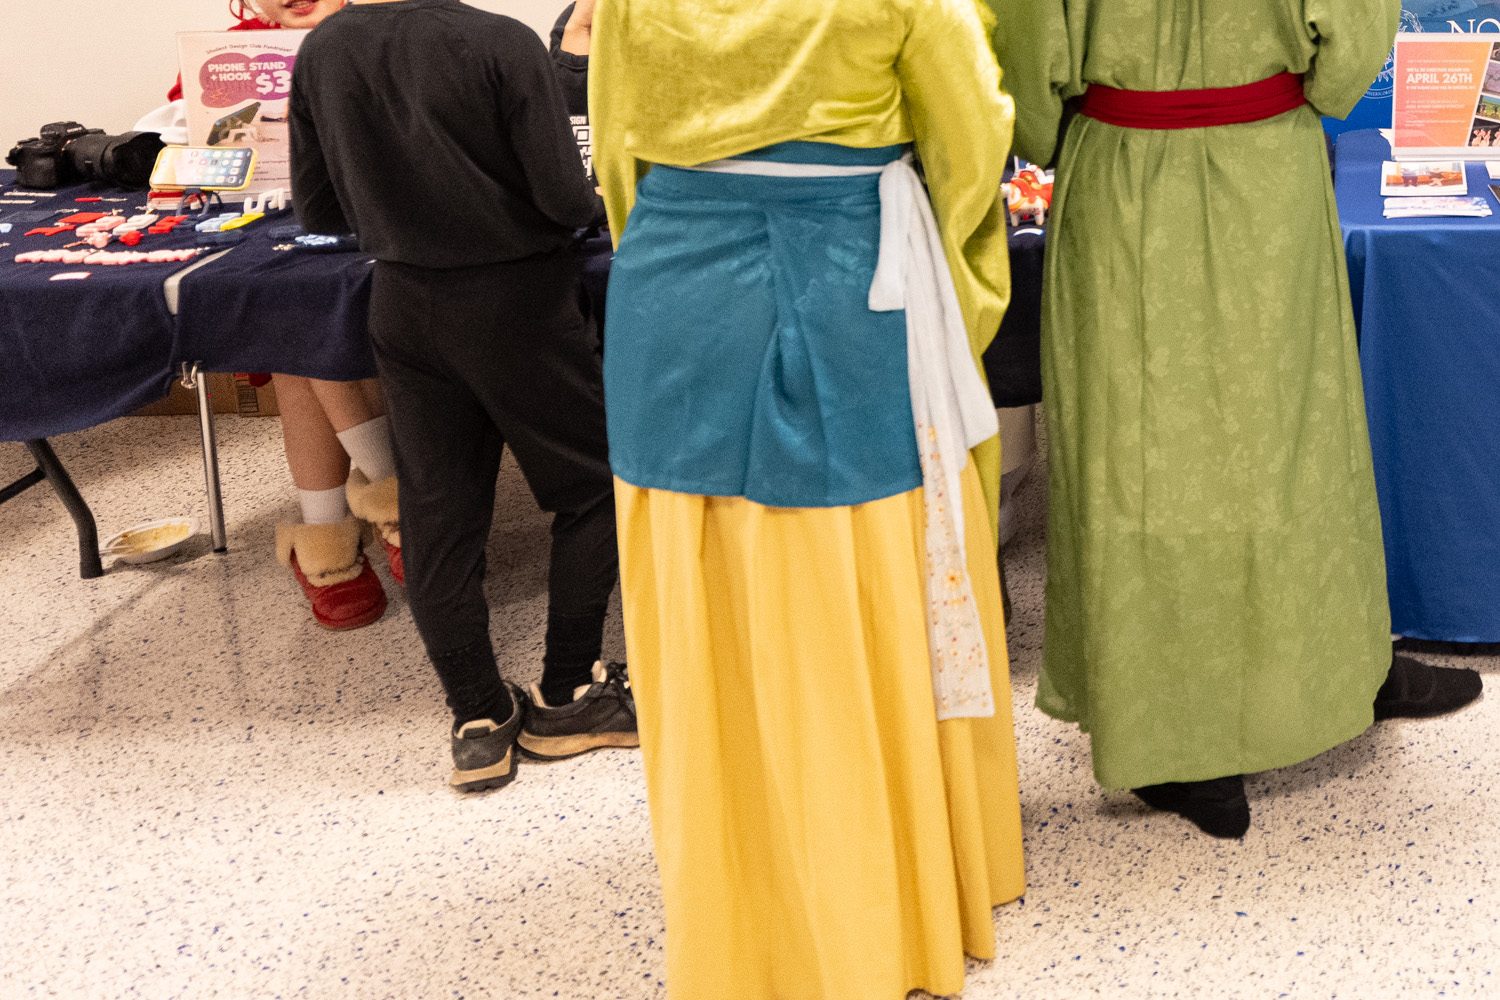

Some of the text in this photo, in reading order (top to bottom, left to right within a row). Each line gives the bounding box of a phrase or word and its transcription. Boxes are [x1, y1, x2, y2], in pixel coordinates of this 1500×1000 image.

[208, 61, 286, 72] PHONE STAND
[219, 72, 252, 82] HOOK
[255, 70, 291, 95] $3
[1406, 73, 1472, 84] APRIL 26TH
